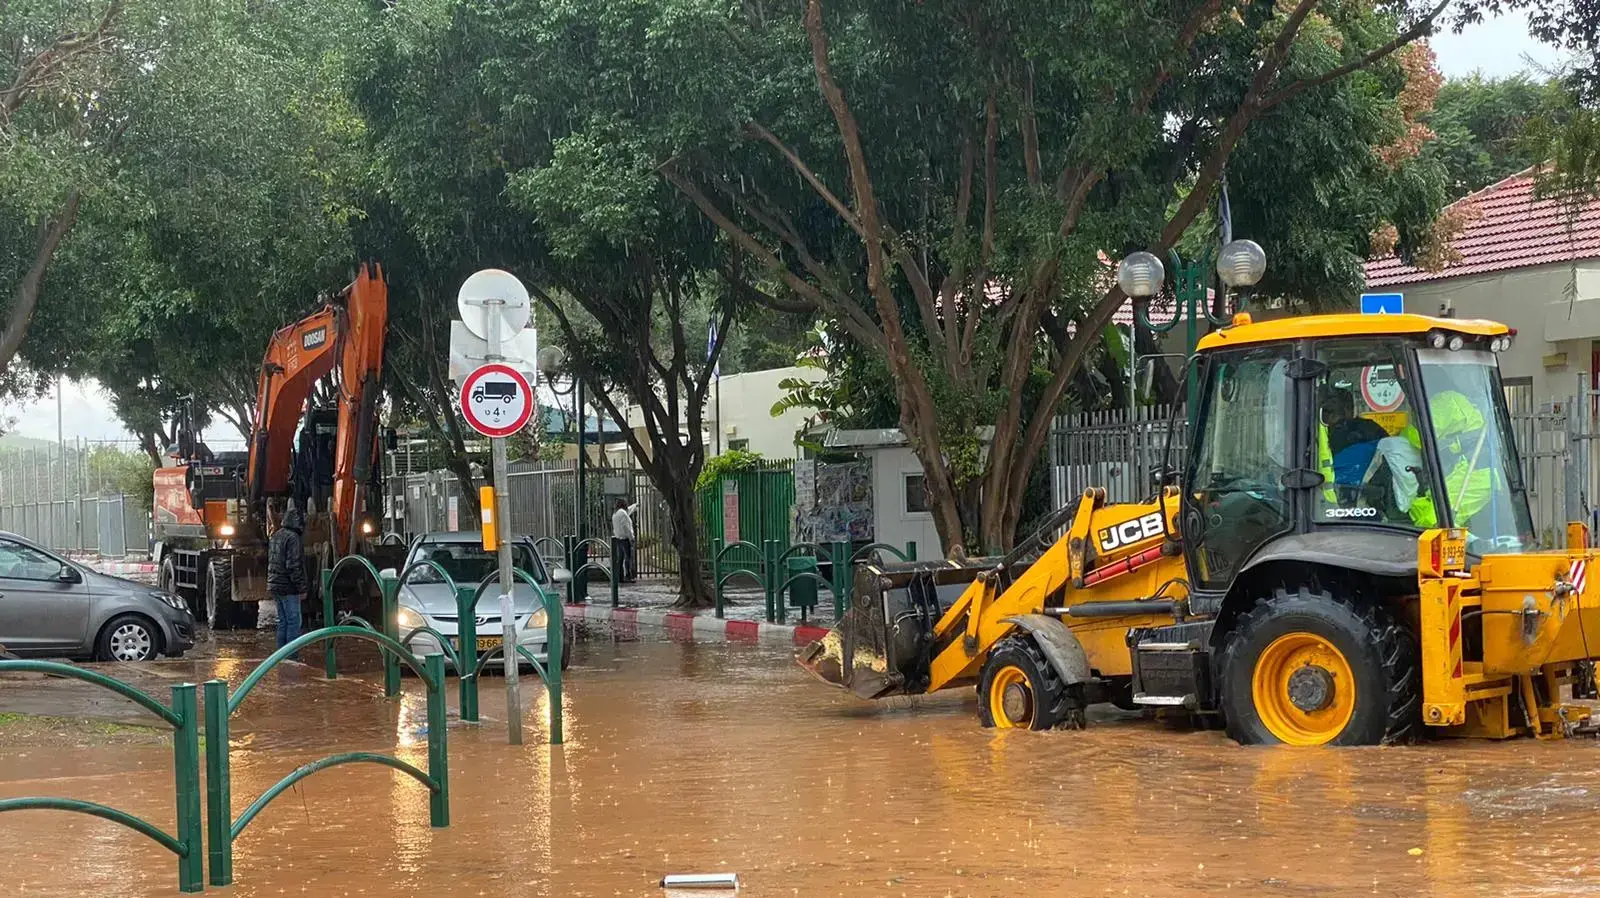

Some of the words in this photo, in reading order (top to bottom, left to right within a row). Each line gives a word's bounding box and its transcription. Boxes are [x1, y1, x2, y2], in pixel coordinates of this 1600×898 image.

[304, 329, 325, 347] DOOSAN
[493, 407, 500, 417] 4
[1101, 512, 1164, 550] JCB
